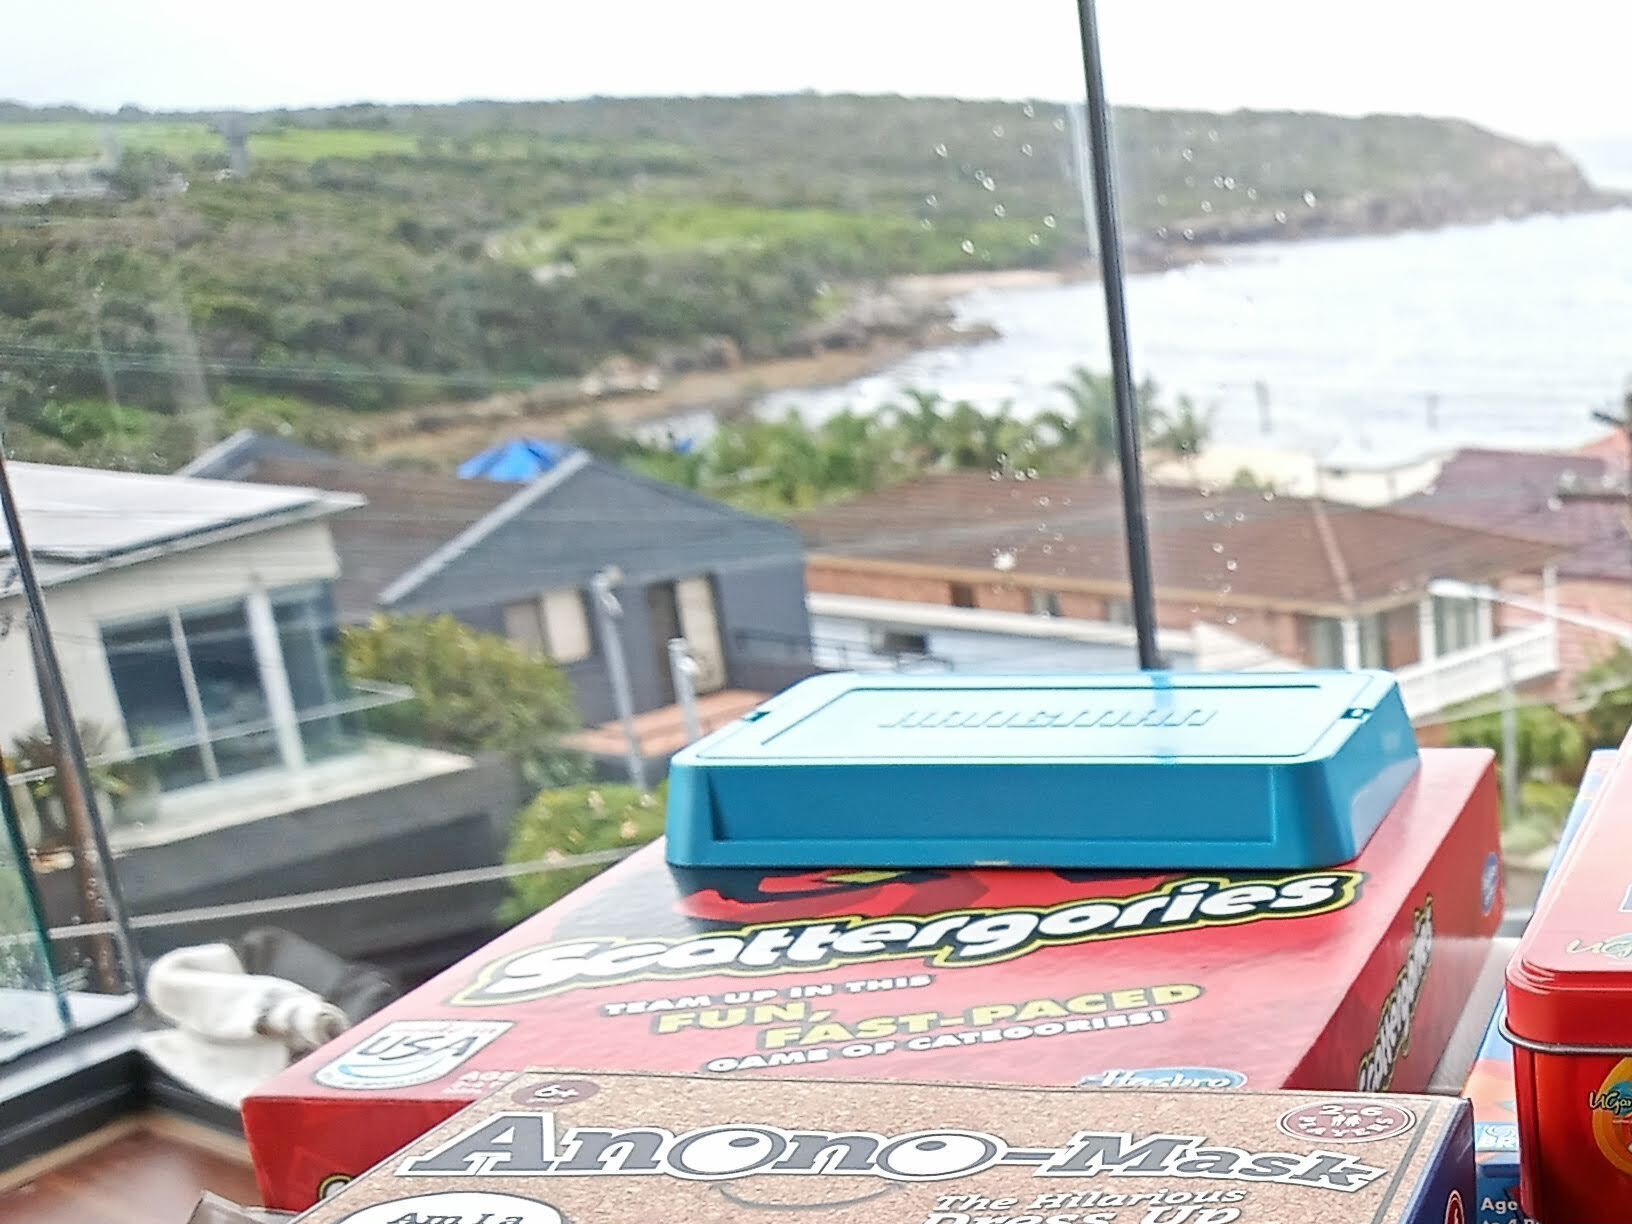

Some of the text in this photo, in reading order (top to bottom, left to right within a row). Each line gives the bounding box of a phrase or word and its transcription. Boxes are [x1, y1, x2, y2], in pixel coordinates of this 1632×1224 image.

[480, 874, 1340, 996] Scattergories
[605, 974, 933, 1015] TEAM UP IN THIS
[657, 1002, 831, 1034] FUN,
[765, 983, 1202, 1048] FAST-PACED
[357, 1035, 479, 1060] USA
[704, 1009, 1167, 1073] GAME OF CATEGORIES!
[1098, 1068, 1233, 1089] Hasbro
[535, 1085, 580, 1099] 6+
[1321, 1104, 1383, 1117] 2-6
[936, 1188, 1248, 1212] The Hilarious
[1480, 1197, 1518, 1214] Age
